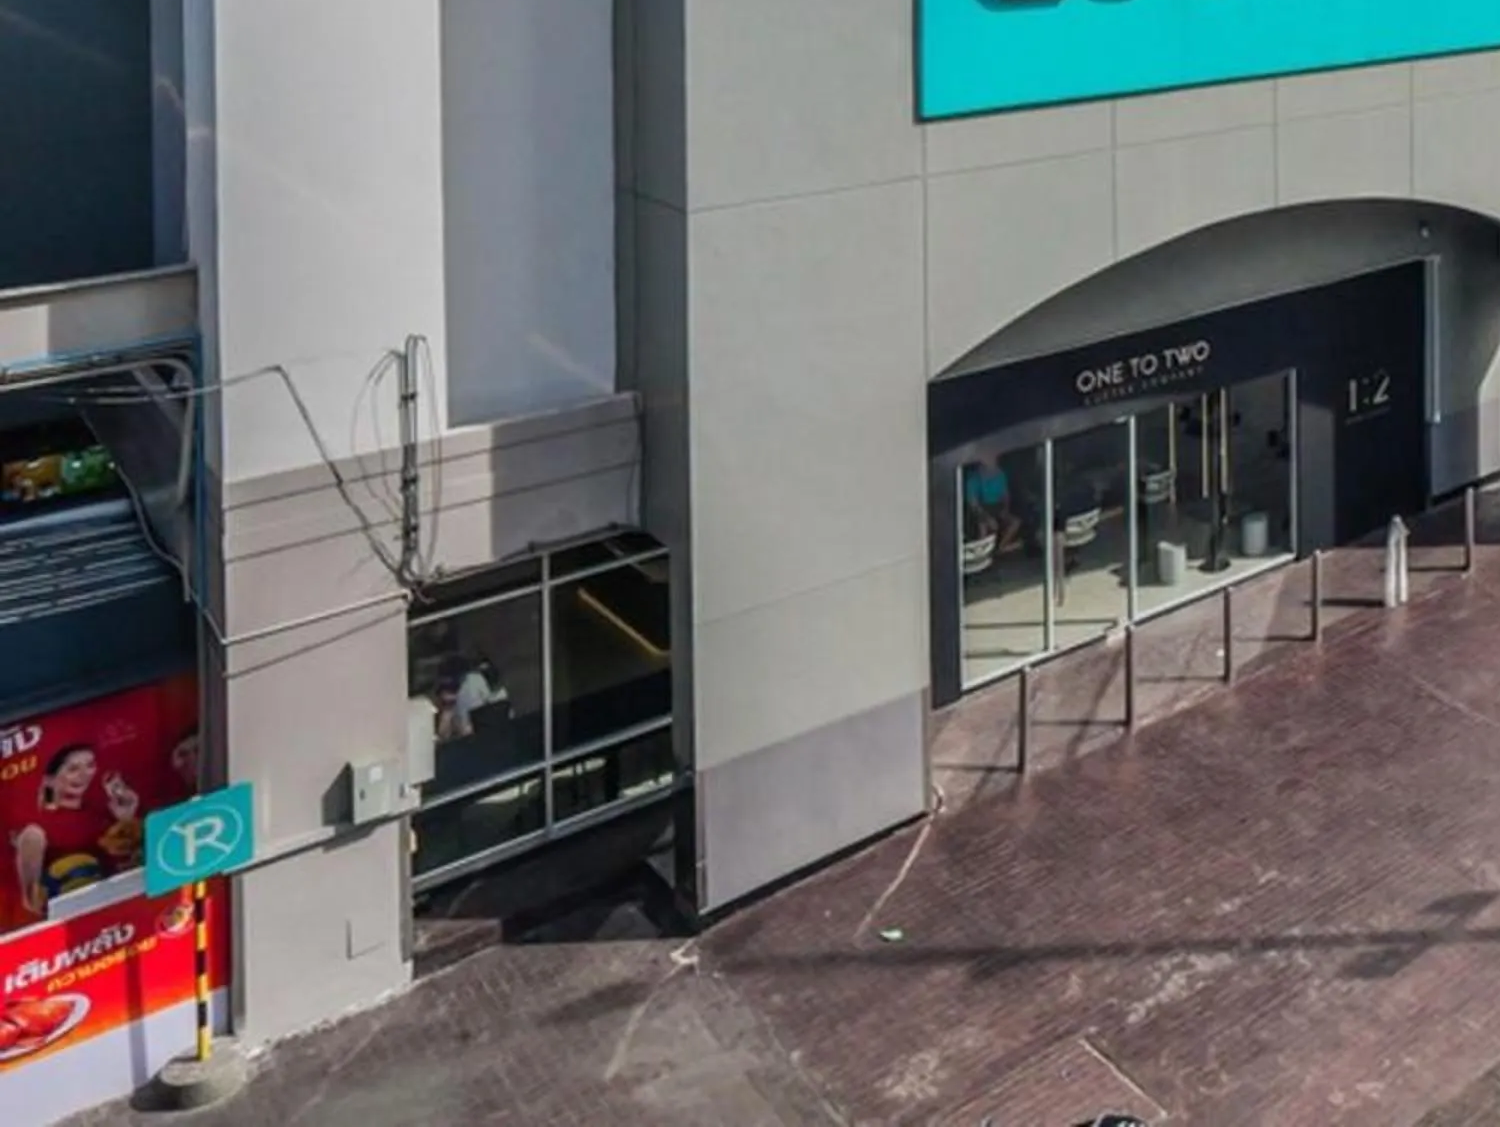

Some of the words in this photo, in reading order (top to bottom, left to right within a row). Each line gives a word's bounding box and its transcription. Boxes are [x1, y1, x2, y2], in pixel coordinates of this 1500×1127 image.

[1075, 360, 1124, 394] ONE
[1129, 353, 1158, 378] TO
[1163, 339, 1211, 370] TWO
